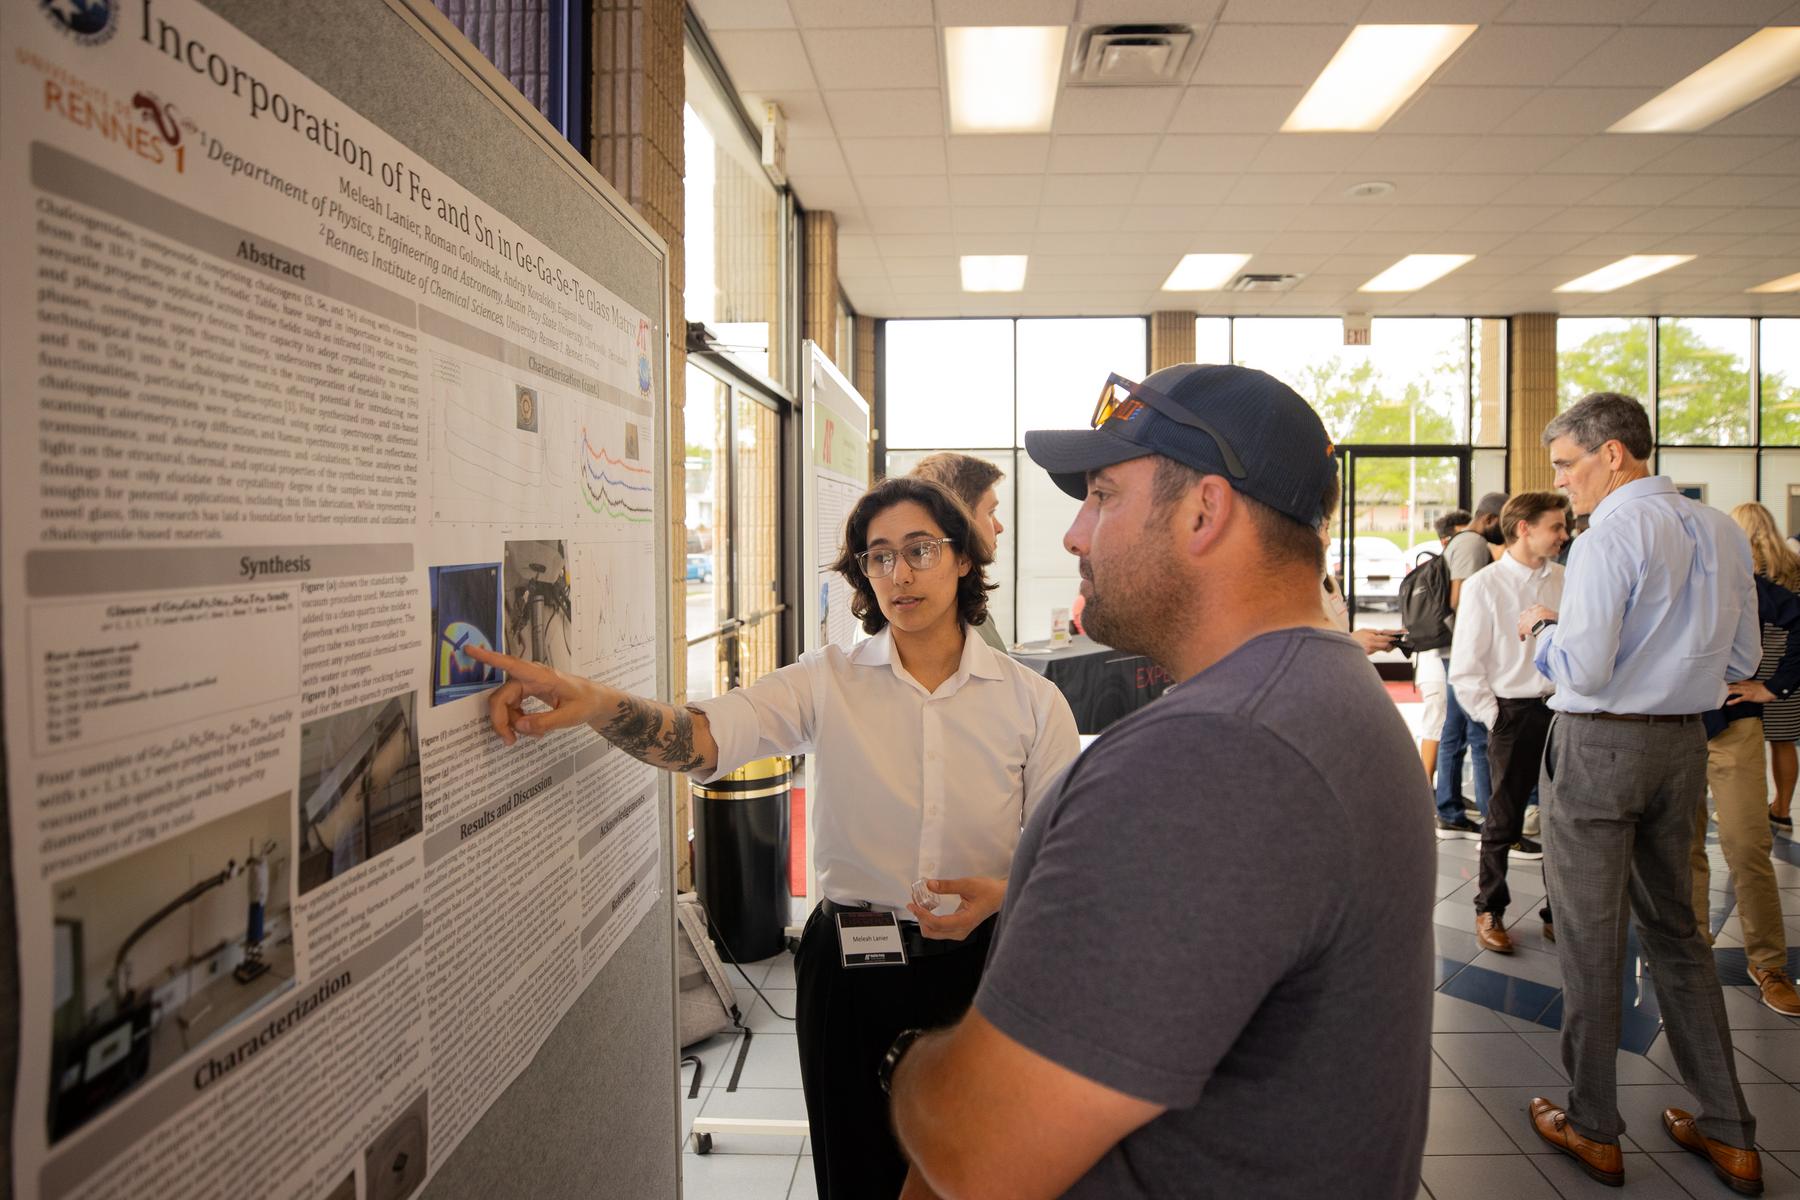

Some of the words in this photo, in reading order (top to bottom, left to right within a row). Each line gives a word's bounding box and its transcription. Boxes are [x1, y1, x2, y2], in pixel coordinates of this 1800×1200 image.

[44, 80, 164, 164] RENNES
[175, 144, 185, 174] 1
[139, 0, 373, 176] Incorporation
[382, 162, 404, 193] of
[408, 170, 431, 210] Fe
[437, 198, 470, 235] and
[475, 214, 494, 250] Sn
[498, 230, 511, 261] in
[516, 242, 584, 305] Ge-Ga-Se-Te
[587, 289, 610, 321] Glass
[612, 305, 636, 339] Matrix
[236, 241, 306, 280] Abstract
[312, 196, 327, 216] of
[329, 201, 374, 240] Physics,
[378, 227, 439, 274] Engineering
[441, 263, 458, 280] and
[460, 271, 502, 302] Astronomy,
[504, 295, 525, 314] Austin
[339, 176, 382, 216] Meleah
[386, 203, 421, 239] Lanier,
[425, 225, 456, 256] Roman
[459, 245, 501, 281] Golovchak,
[372, 251, 416, 286] Institute
[419, 276, 429, 294] of
[430, 279, 469, 309] Chemical
[471, 299, 504, 327] Sciences,
[506, 315, 537, 344] University
[1347, 328, 1368, 344] EXIT
[529, 356, 580, 388] Characterization
[239, 555, 311, 579] Synthesis
[460, 808, 495, 841] Results
[497, 799, 512, 820] and
[514, 775, 552, 808] Discussion
[194, 971, 351, 1090] Characterization
